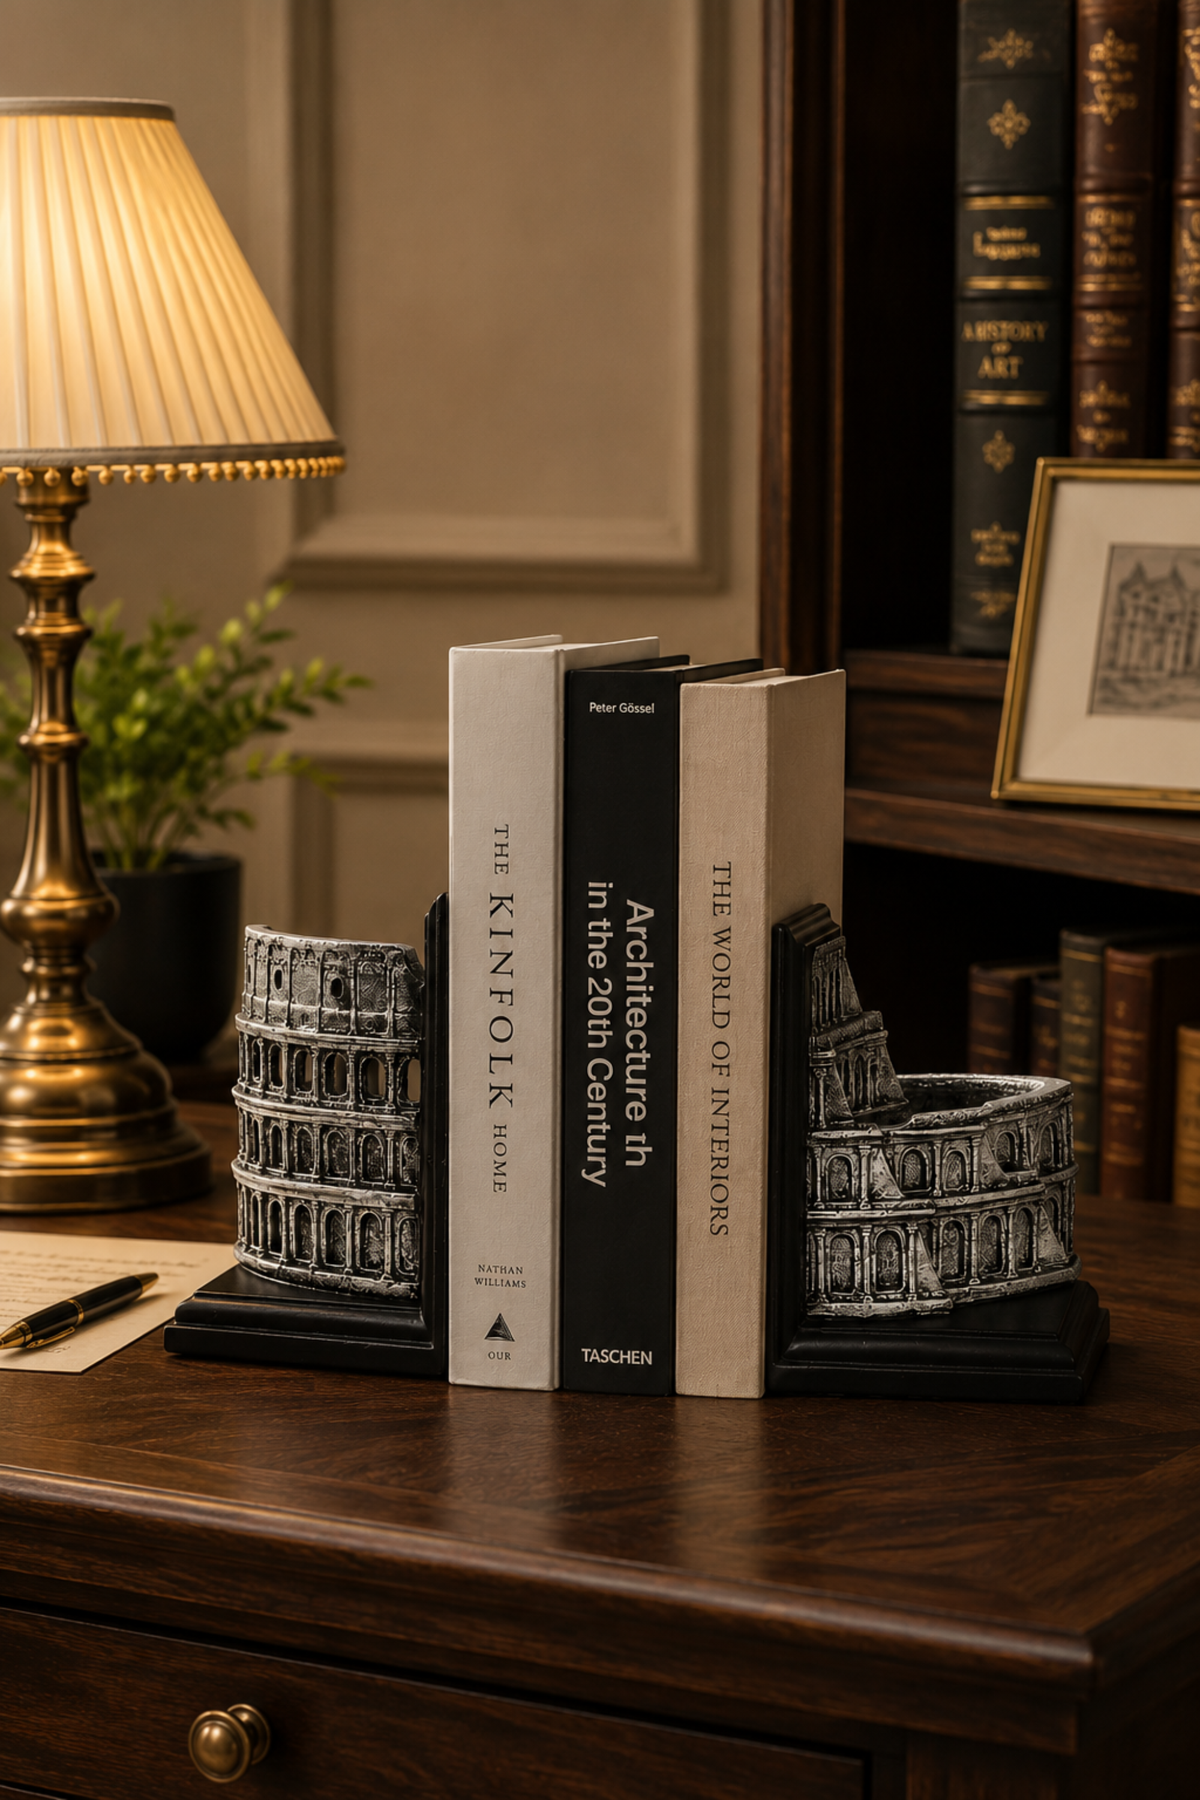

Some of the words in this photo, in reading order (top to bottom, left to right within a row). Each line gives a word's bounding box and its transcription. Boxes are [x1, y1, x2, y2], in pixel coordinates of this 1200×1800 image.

[977, 355, 1024, 379] ART
[589, 701, 617, 714] Peter
[618, 701, 655, 714] Gössel
[494, 823, 509, 875] THE
[587, 881, 614, 909] in
[712, 861, 732, 917] THE
[587, 917, 614, 970] the
[489, 892, 514, 1109] KINFOLK
[711, 925, 732, 1030] WORLD
[587, 976, 614, 1049] 20th
[625, 898, 655, 1122] Architecture
[711, 1040, 731, 1078] OF
[580, 1057, 614, 1188] Century
[492, 1124, 508, 1193] HOME
[709, 1086, 730, 1236] INTERIORS
[474, 1277, 527, 1289] WILLIAMS
[478, 1264, 524, 1275] NATHAN
[487, 1351, 512, 1361] OUR
[581, 1347, 653, 1366] TASCHEN
